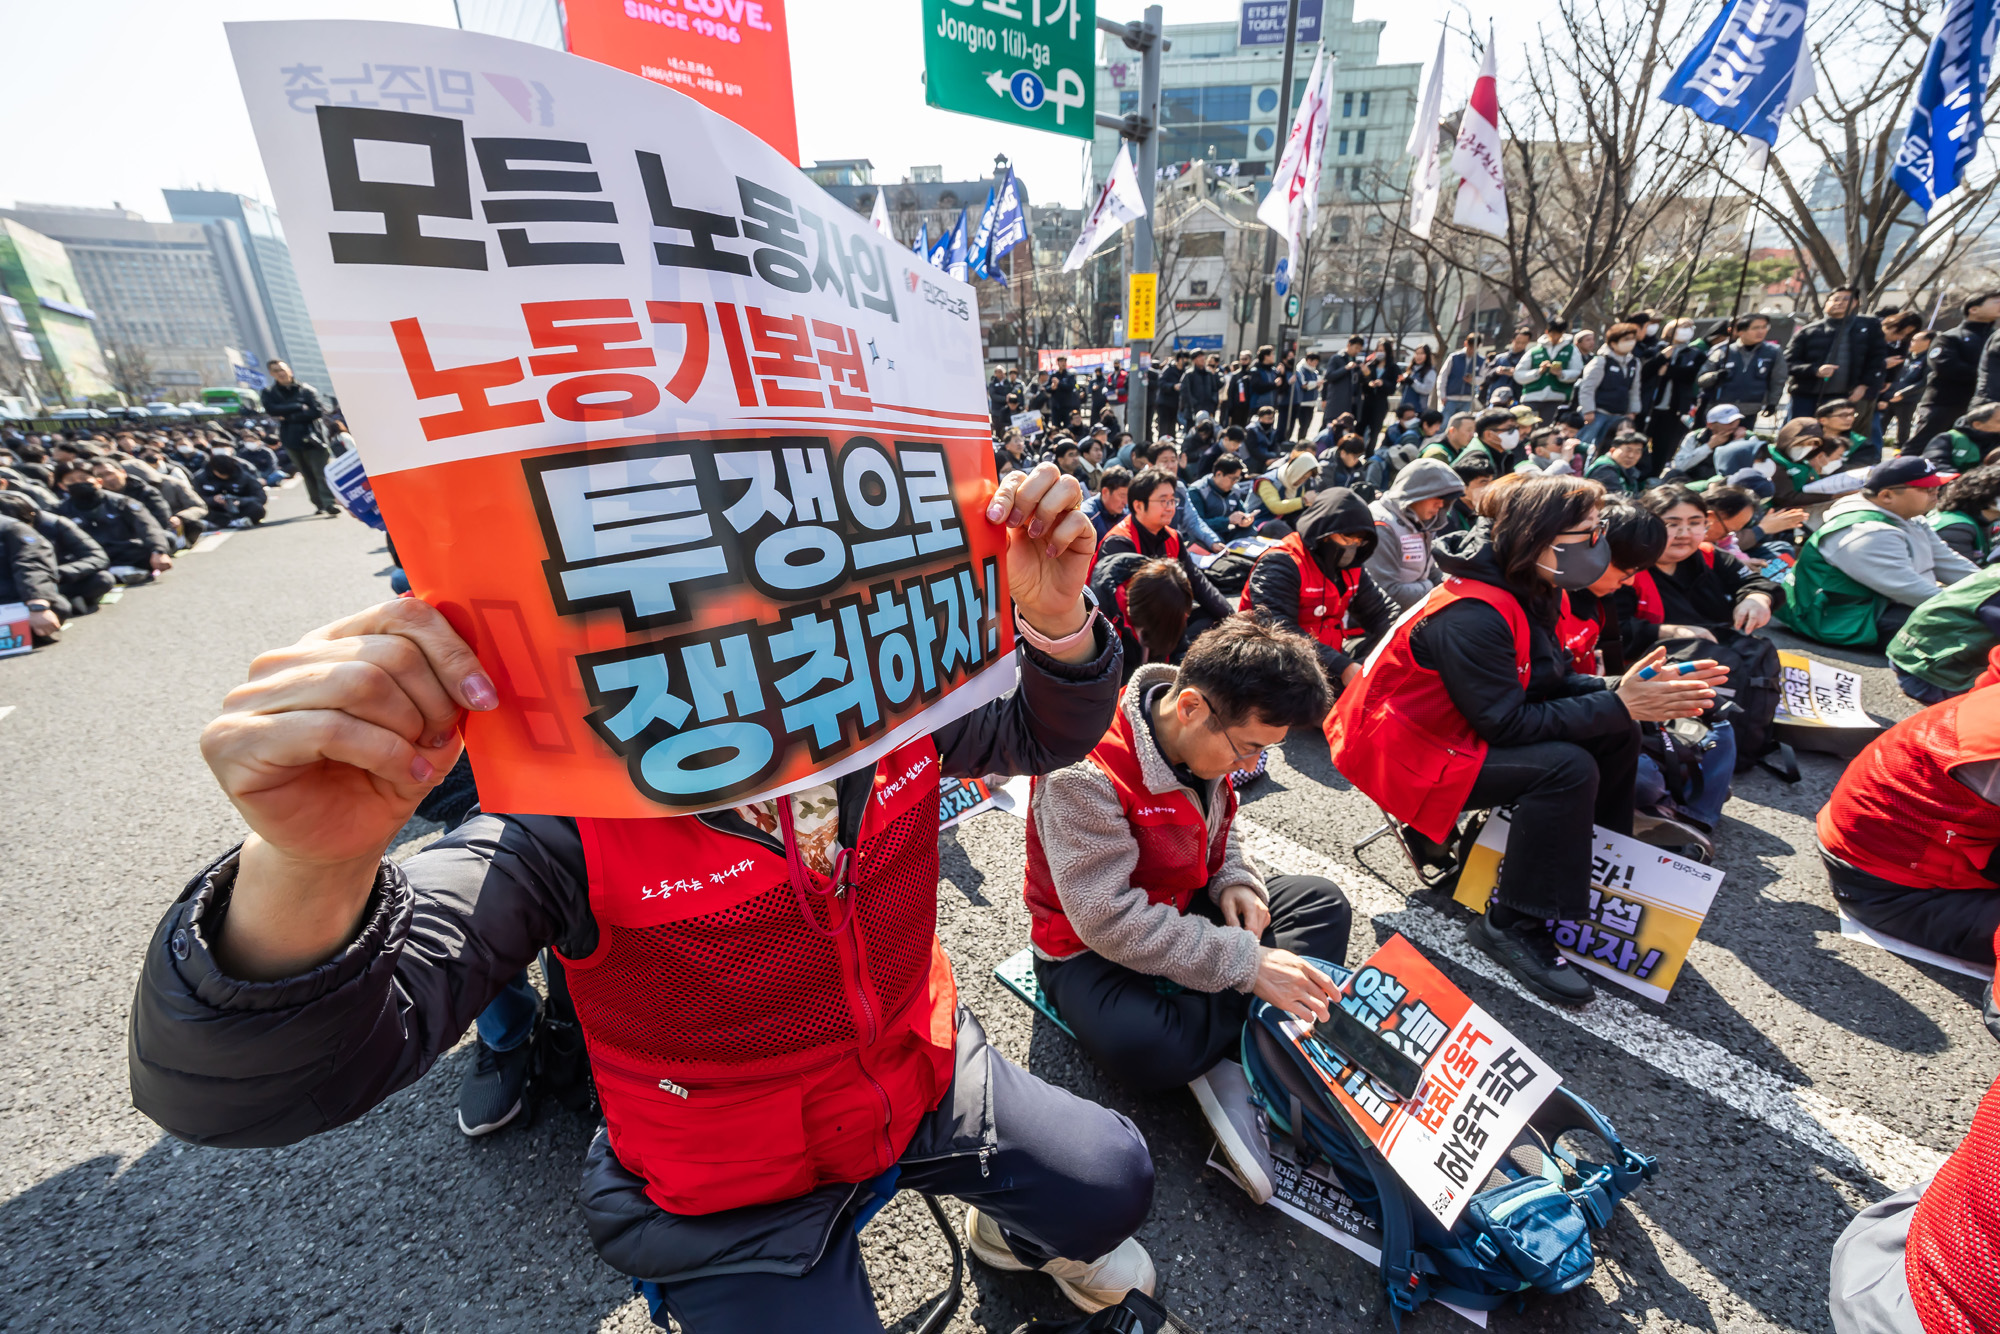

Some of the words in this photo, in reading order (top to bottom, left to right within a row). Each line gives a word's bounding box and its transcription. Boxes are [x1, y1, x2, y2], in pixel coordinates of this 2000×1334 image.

[623, 0, 690, 32] SINCE
[691, 17, 742, 44] 1986
[937, 8, 997, 53] Jongno
[1001, 28, 1050, 70] 1(il)-ga
[1247, 18, 1279, 32] TOEFL
[1021, 76, 1034, 104] 6
[315, 105, 625, 271] 모든
[635, 150, 900, 323] 노동자의
[390, 299, 874, 443] 노동기본권
[540, 446, 967, 618] 투쟁으로
[592, 563, 997, 794] 쟁취하자!
[641, 878, 704, 901] 노동자는
[1672, 860, 1713, 883] 민주노총
[1407, 1021, 1494, 1135] 노동기본권
[1477, 1046, 1539, 1107] 모든
[1433, 1093, 1500, 1190] 노동자의
